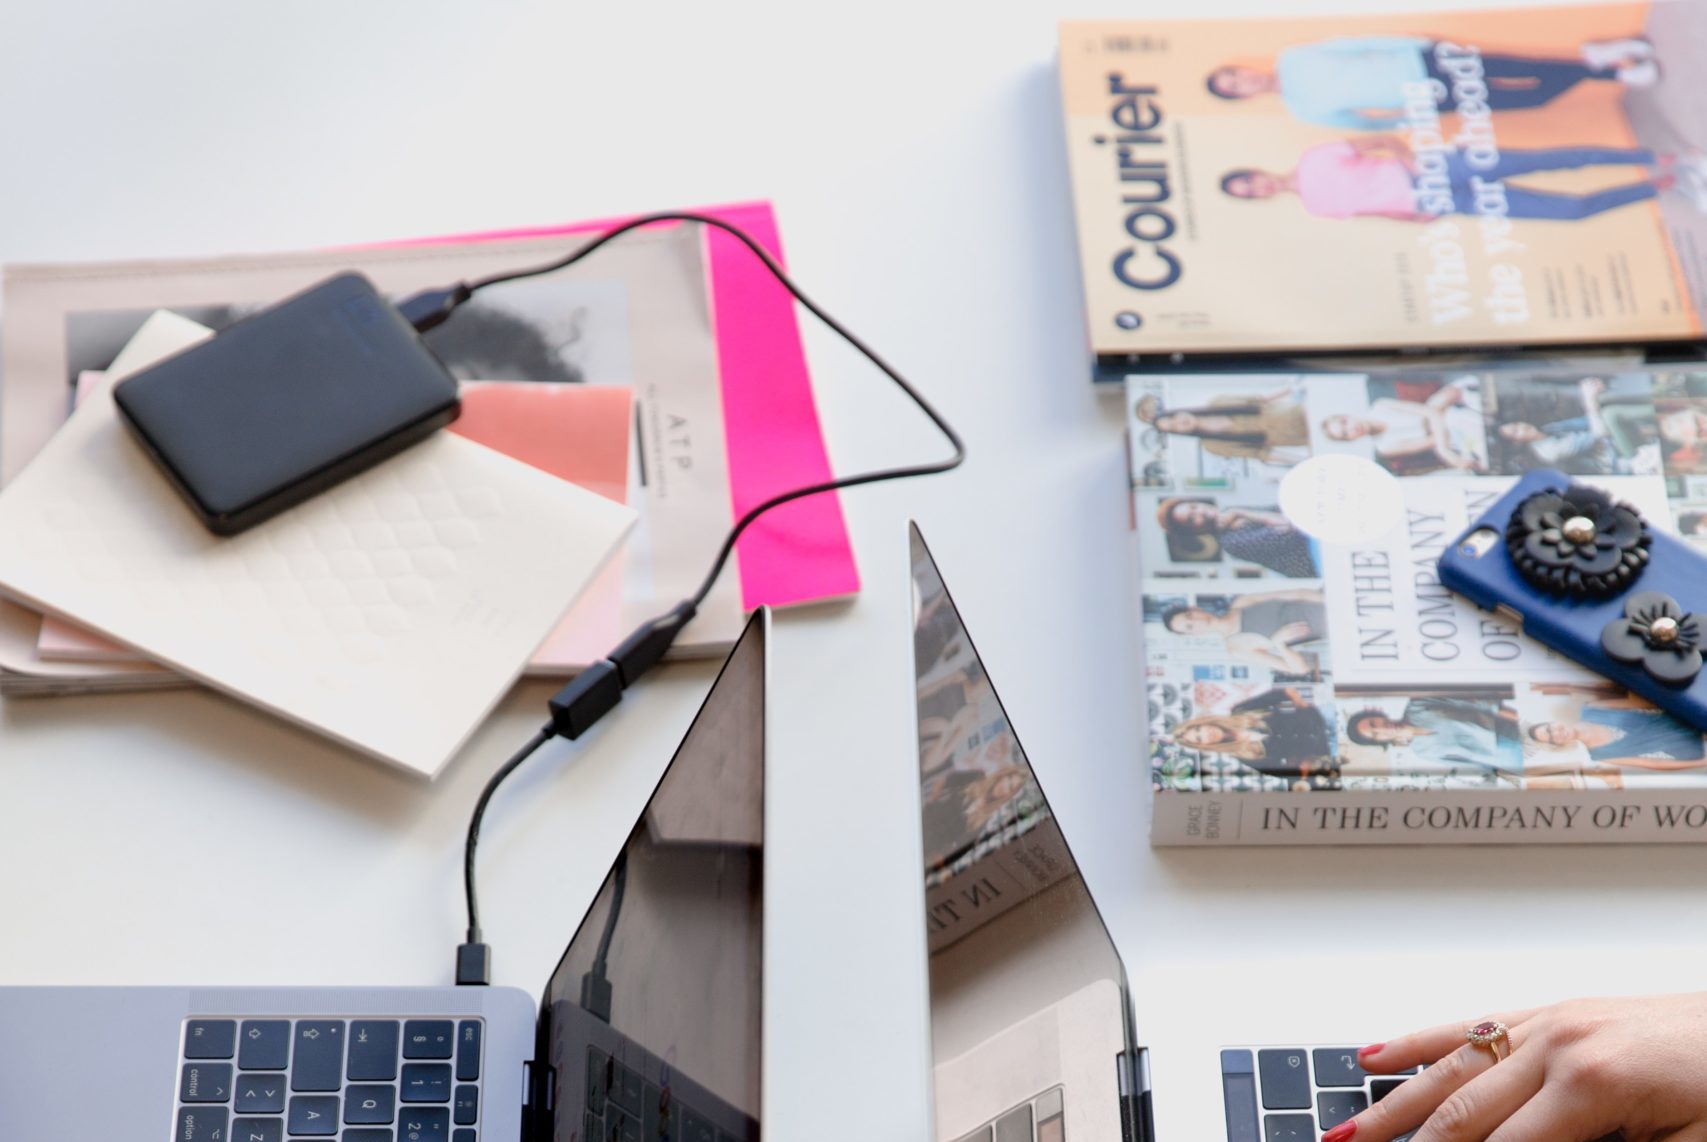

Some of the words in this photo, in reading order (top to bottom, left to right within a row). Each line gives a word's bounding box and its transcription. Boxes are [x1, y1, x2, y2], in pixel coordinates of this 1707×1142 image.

[1438, 42, 1498, 169] ahead?
[1398, 80, 1456, 215] shaping
[1091, 73, 1182, 291] Courier
[1468, 177, 1523, 254] year
[1424, 222, 1473, 325] Who's
[1479, 263, 1529, 325] the
[1351, 549, 1393, 619] THE
[1360, 623, 1399, 662] IN
[1482, 621, 1521, 662] OF
[1186, 805, 1202, 836] GRACE
[1204, 800, 1223, 840] BONNEY
[1261, 807, 1300, 831] IN
[1313, 806, 1390, 831] THE
[1402, 804, 1581, 831] COMPANY
[1592, 804, 1641, 830] OF
[189, 1069, 198, 1096] control
[308, 1111, 320, 1119] A
[362, 1100, 376, 1108] Q
[185, 1115, 194, 1139] option
